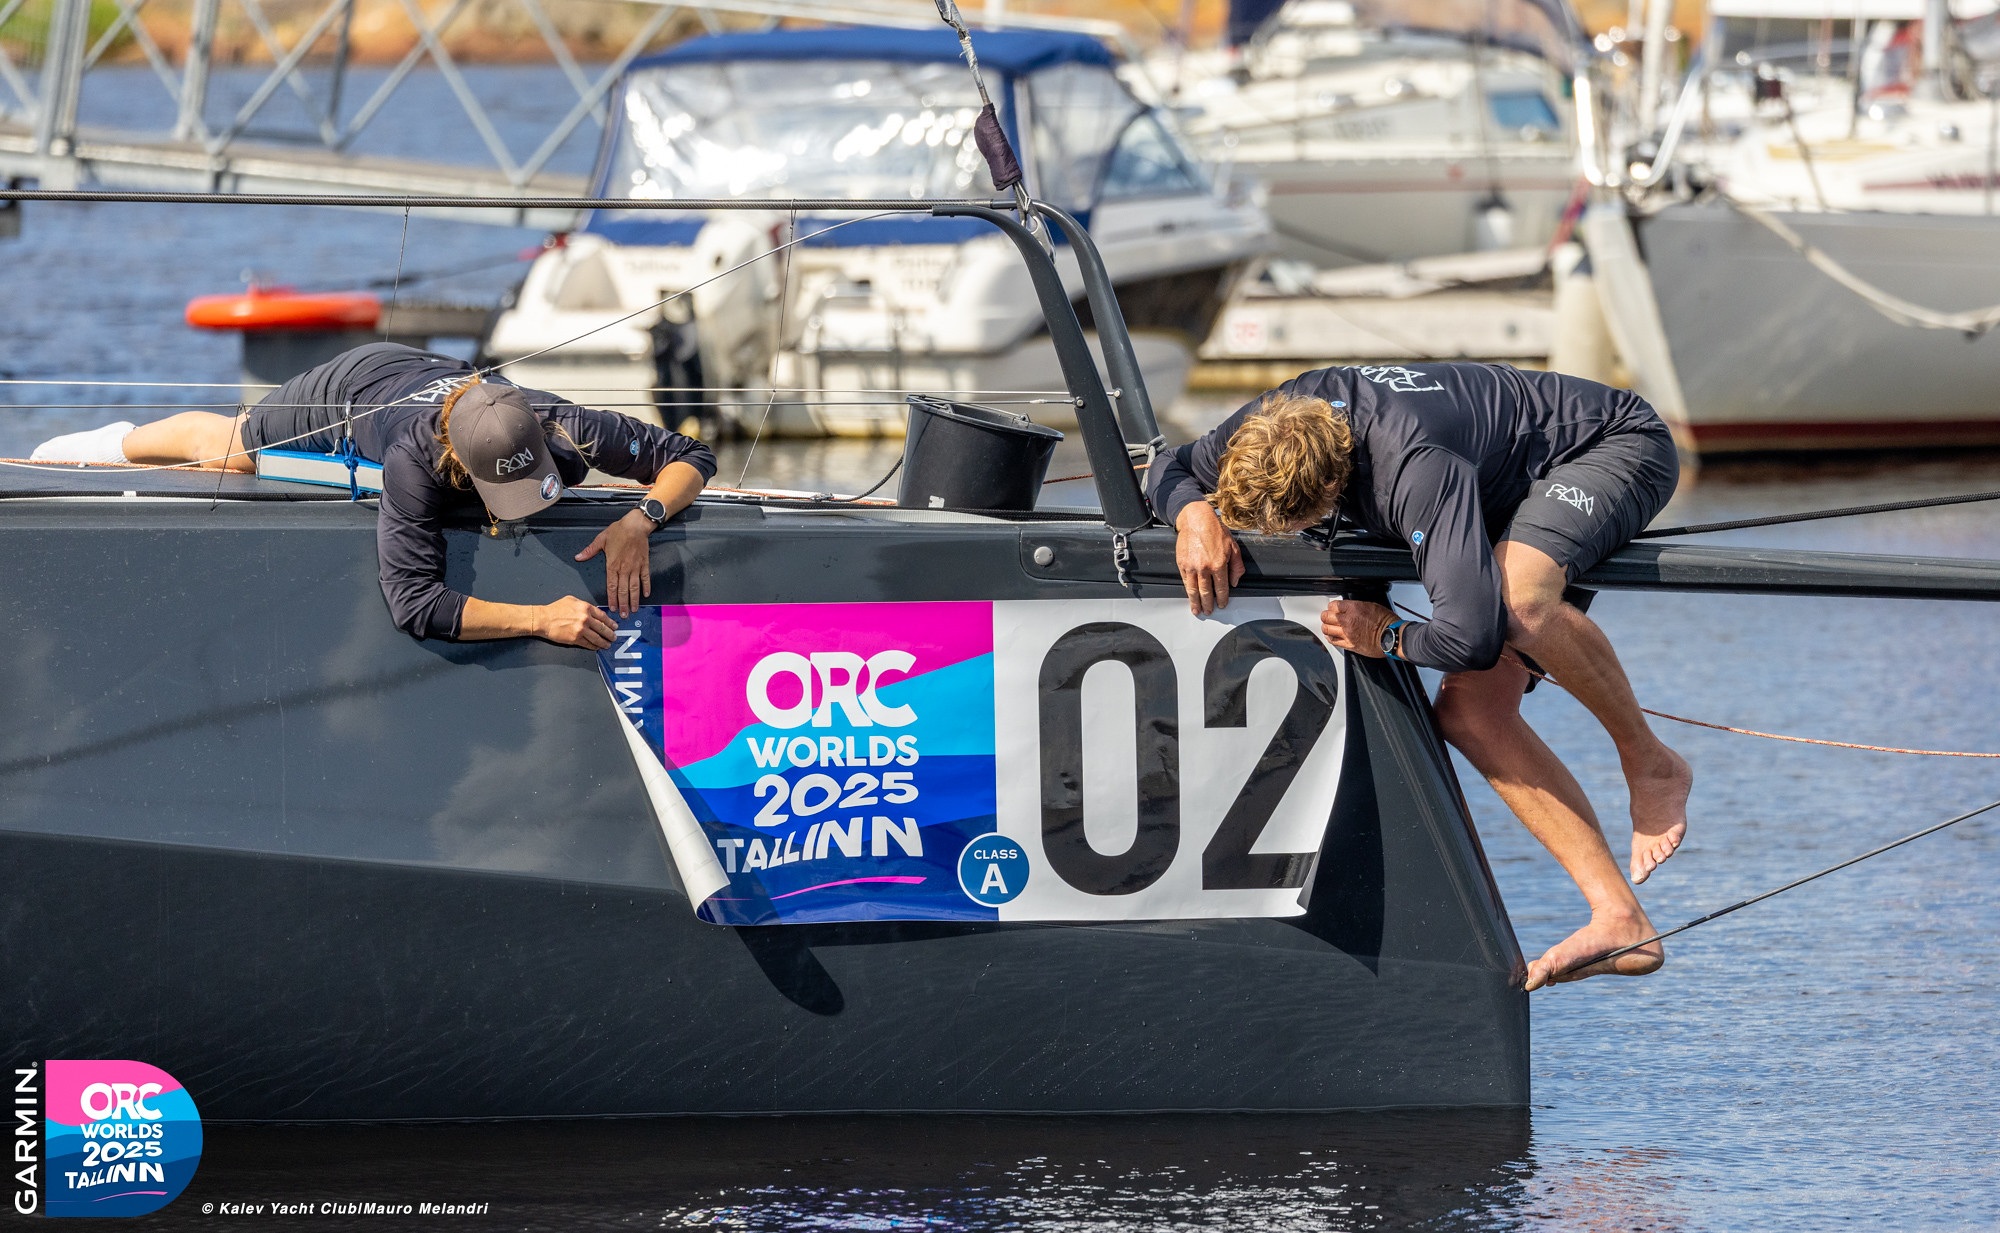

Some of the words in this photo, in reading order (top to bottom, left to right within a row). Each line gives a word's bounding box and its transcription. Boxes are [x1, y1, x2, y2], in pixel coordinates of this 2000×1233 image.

[614, 629, 644, 731] MIN
[746, 650, 918, 729] ORC
[746, 735, 920, 767] WORLDS
[1038, 619, 1339, 896] 02
[753, 772, 919, 827] 2025
[716, 816, 924, 873] TALLINN
[973, 849, 1018, 860] CLASS
[980, 863, 1008, 894] A
